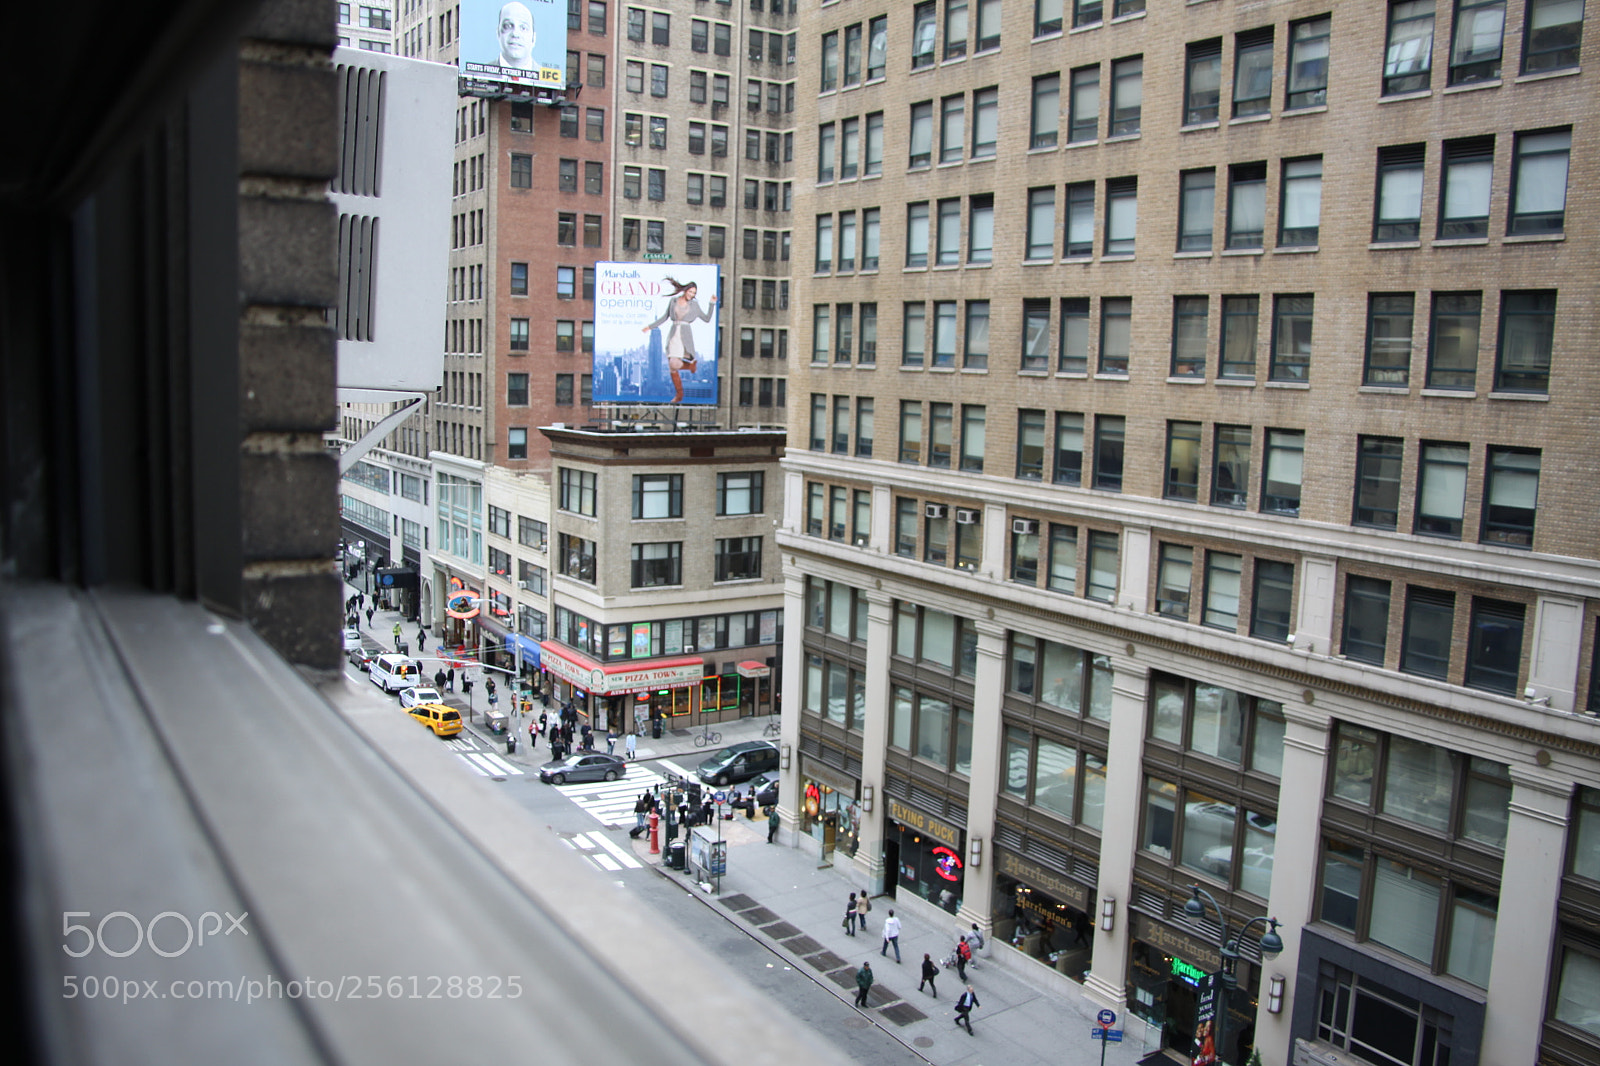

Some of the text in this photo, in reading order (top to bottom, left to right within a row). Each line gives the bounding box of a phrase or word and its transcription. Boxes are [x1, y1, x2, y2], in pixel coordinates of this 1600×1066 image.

[466, 63, 484, 72] STARTS
[501, 67, 522, 77] OCTOBER
[542, 70, 559, 80] IFC
[601, 269, 641, 278] Marshalls
[600, 280, 661, 296] GRAND
[600, 298, 653, 310] opening
[547, 654, 562, 666] PIZZA
[564, 662, 580, 676] TOWN
[625, 672, 649, 682] PIZZA
[653, 670, 677, 679] TOWN
[670, 680, 701, 689] INTERNET
[892, 802, 955, 843] FLYING PUCK
[1004, 852, 1083, 900] Harrington's
[1016, 892, 1072, 928] Harrington's
